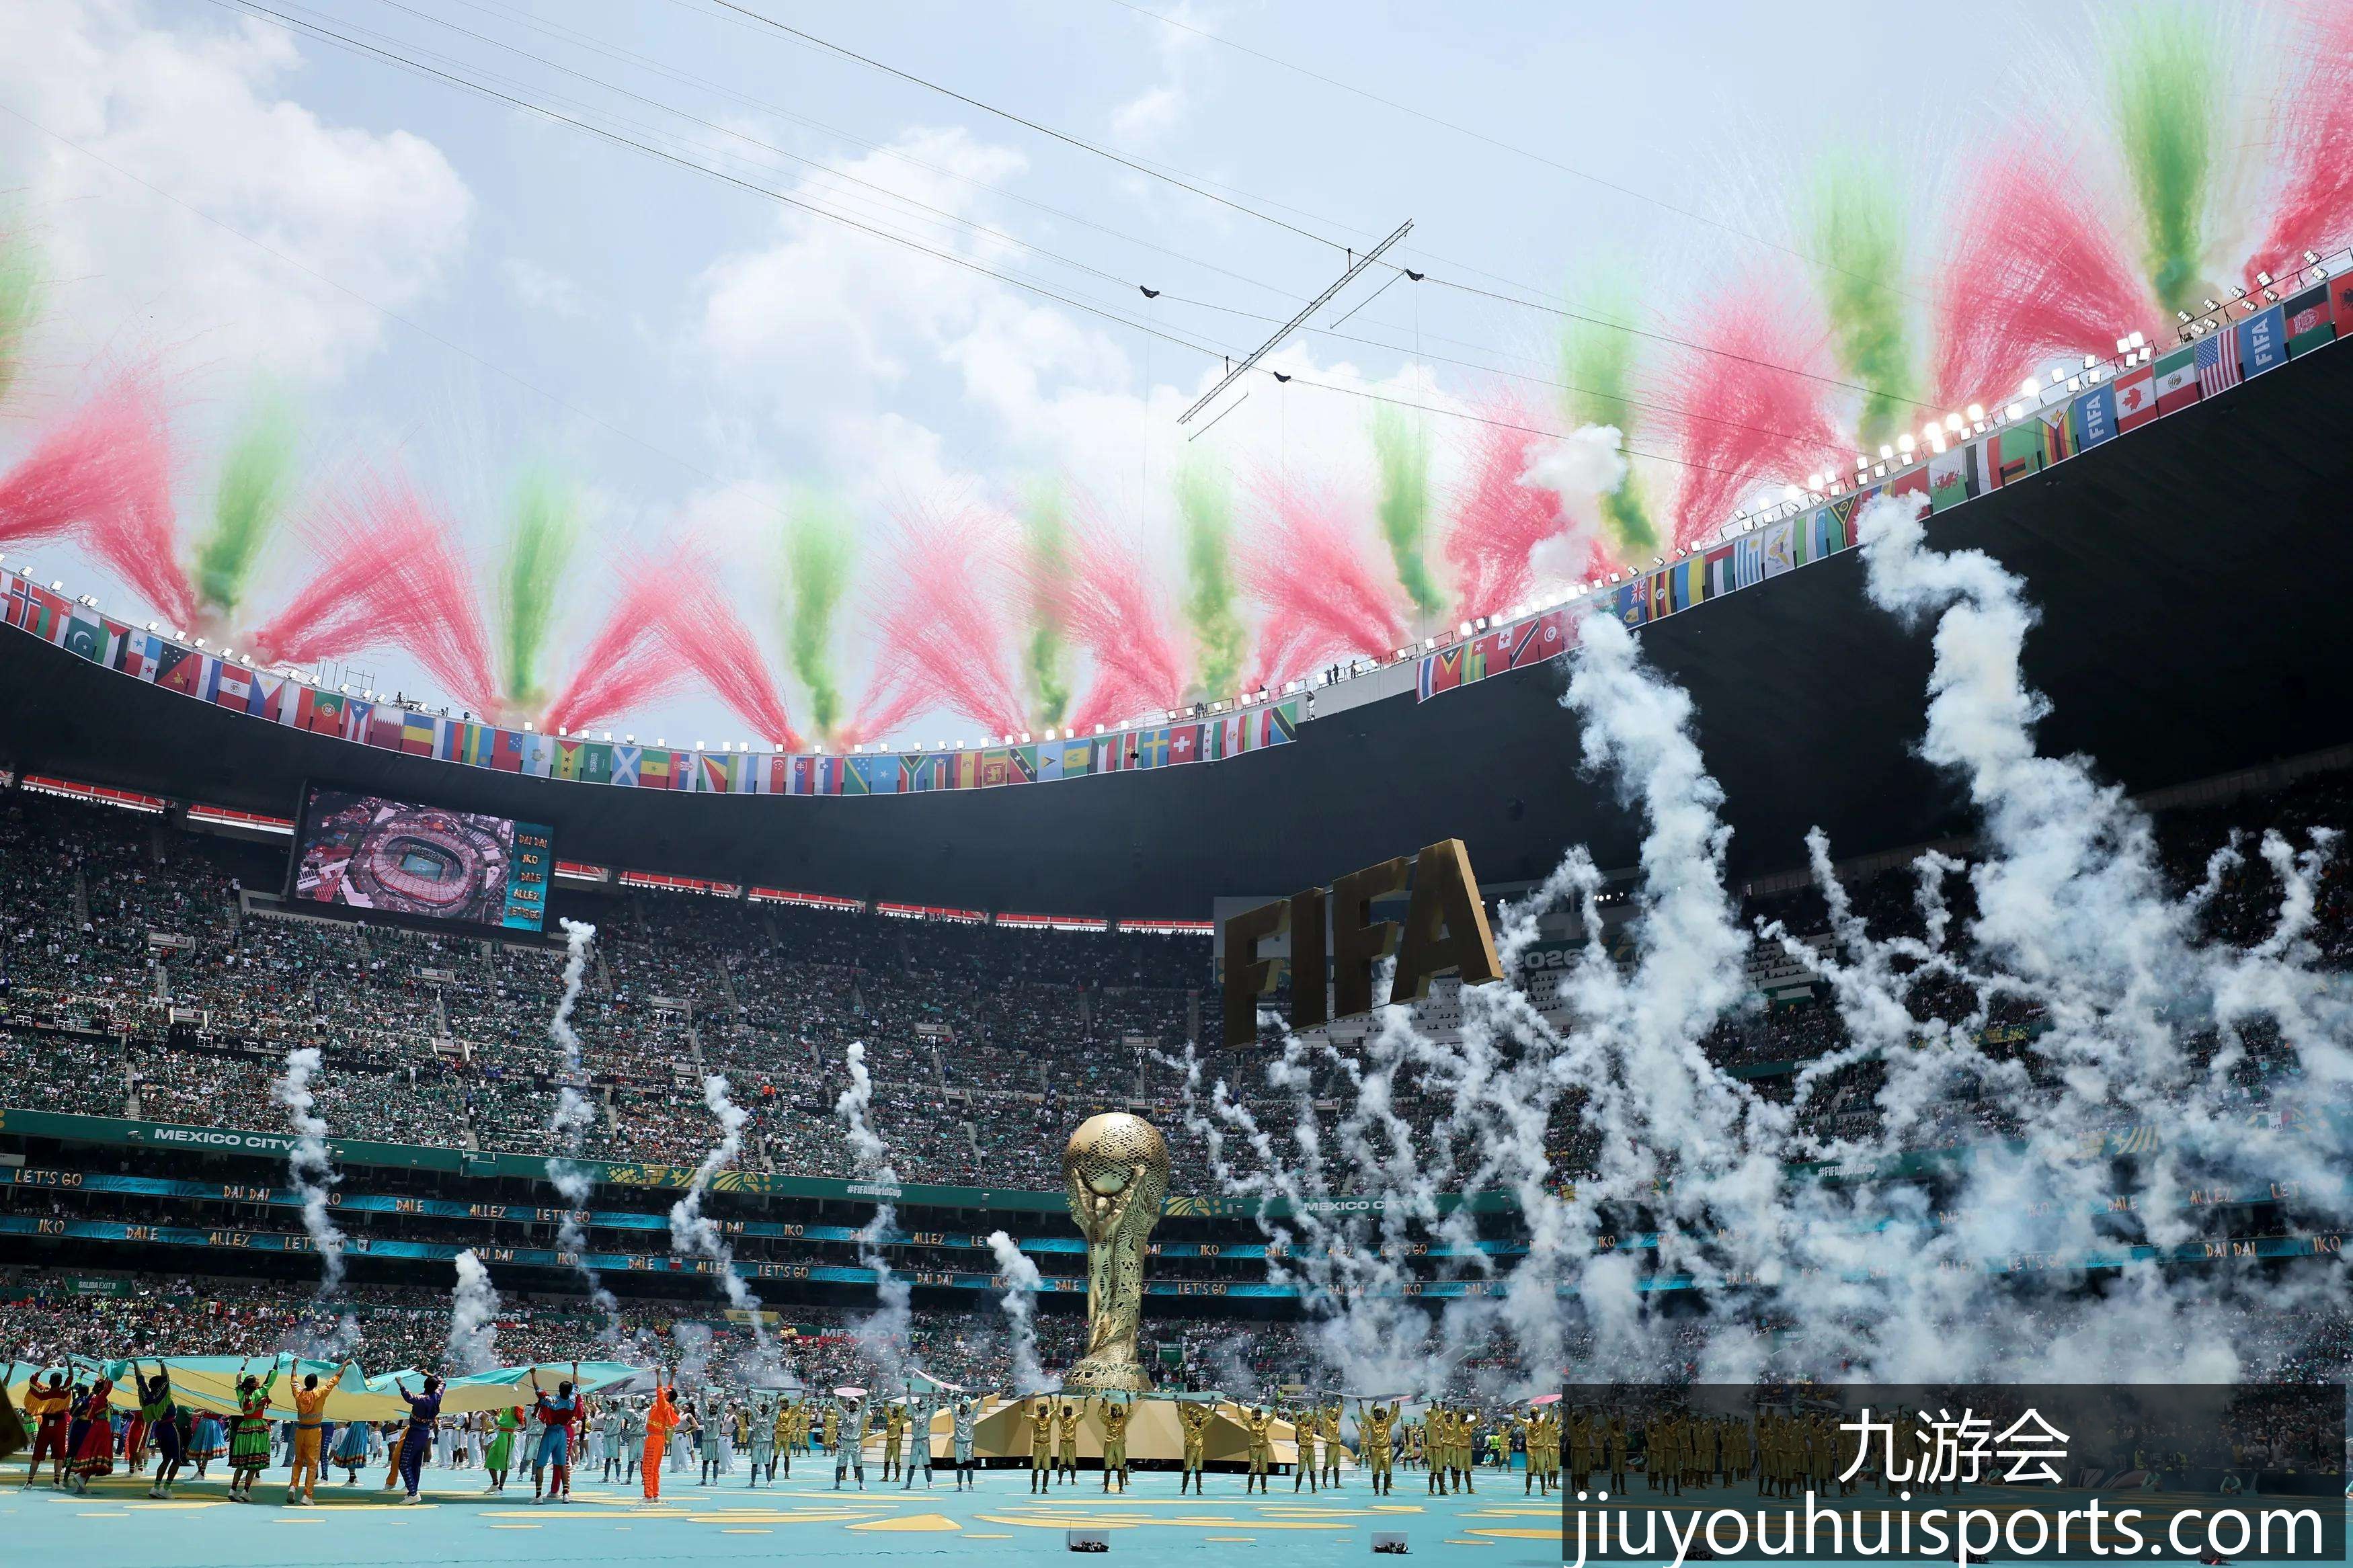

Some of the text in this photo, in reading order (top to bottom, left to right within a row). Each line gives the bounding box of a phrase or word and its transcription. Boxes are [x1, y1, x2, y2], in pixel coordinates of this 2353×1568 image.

[2251, 317, 2273, 367] FIFA
[2087, 394, 2105, 440] FIFA
[1224, 837, 1505, 1050] FIFA
[154, 1128, 296, 1150] MEXICO CITY
[15, 1169, 82, 1187] LET'S GO
[224, 1185, 270, 1201] DAI DAI
[846, 1184, 902, 1198] #FIFAWorldCup
[395, 1199, 425, 1212] DALE
[470, 1204, 506, 1219] ALLEZ
[1304, 1200, 1370, 1211] MEXICO
[574, 1211, 590, 1223] GO
[38, 1219, 65, 1234] IKO
[126, 1225, 159, 1241] DALE
[726, 1221, 744, 1233] DAI
[785, 1224, 803, 1236] IKO
[209, 1231, 251, 1248] ALLEZ
[913, 1232, 945, 1245] ALLEZ
[1598, 1235, 1616, 1248] IKO
[2313, 1235, 2342, 1252] IKO
[495, 1249, 514, 1262] DAI
[1145, 1244, 1161, 1255] DAI
[1201, 1244, 1219, 1256] IKO
[1265, 1246, 1289, 1257] DALE
[1413, 1243, 1427, 1255] GO
[2205, 1241, 2257, 1257] DAI DAI
[557, 1252, 579, 1266] IKO
[628, 1257, 653, 1270] DALE
[758, 1264, 809, 1278] LET'S GO
[917, 1272, 953, 1286] DAI DAI
[1055, 1280, 1079, 1291] DALE
[1178, 1282, 1227, 1296] LET'S GO
[1403, 1283, 1421, 1296] IKO
